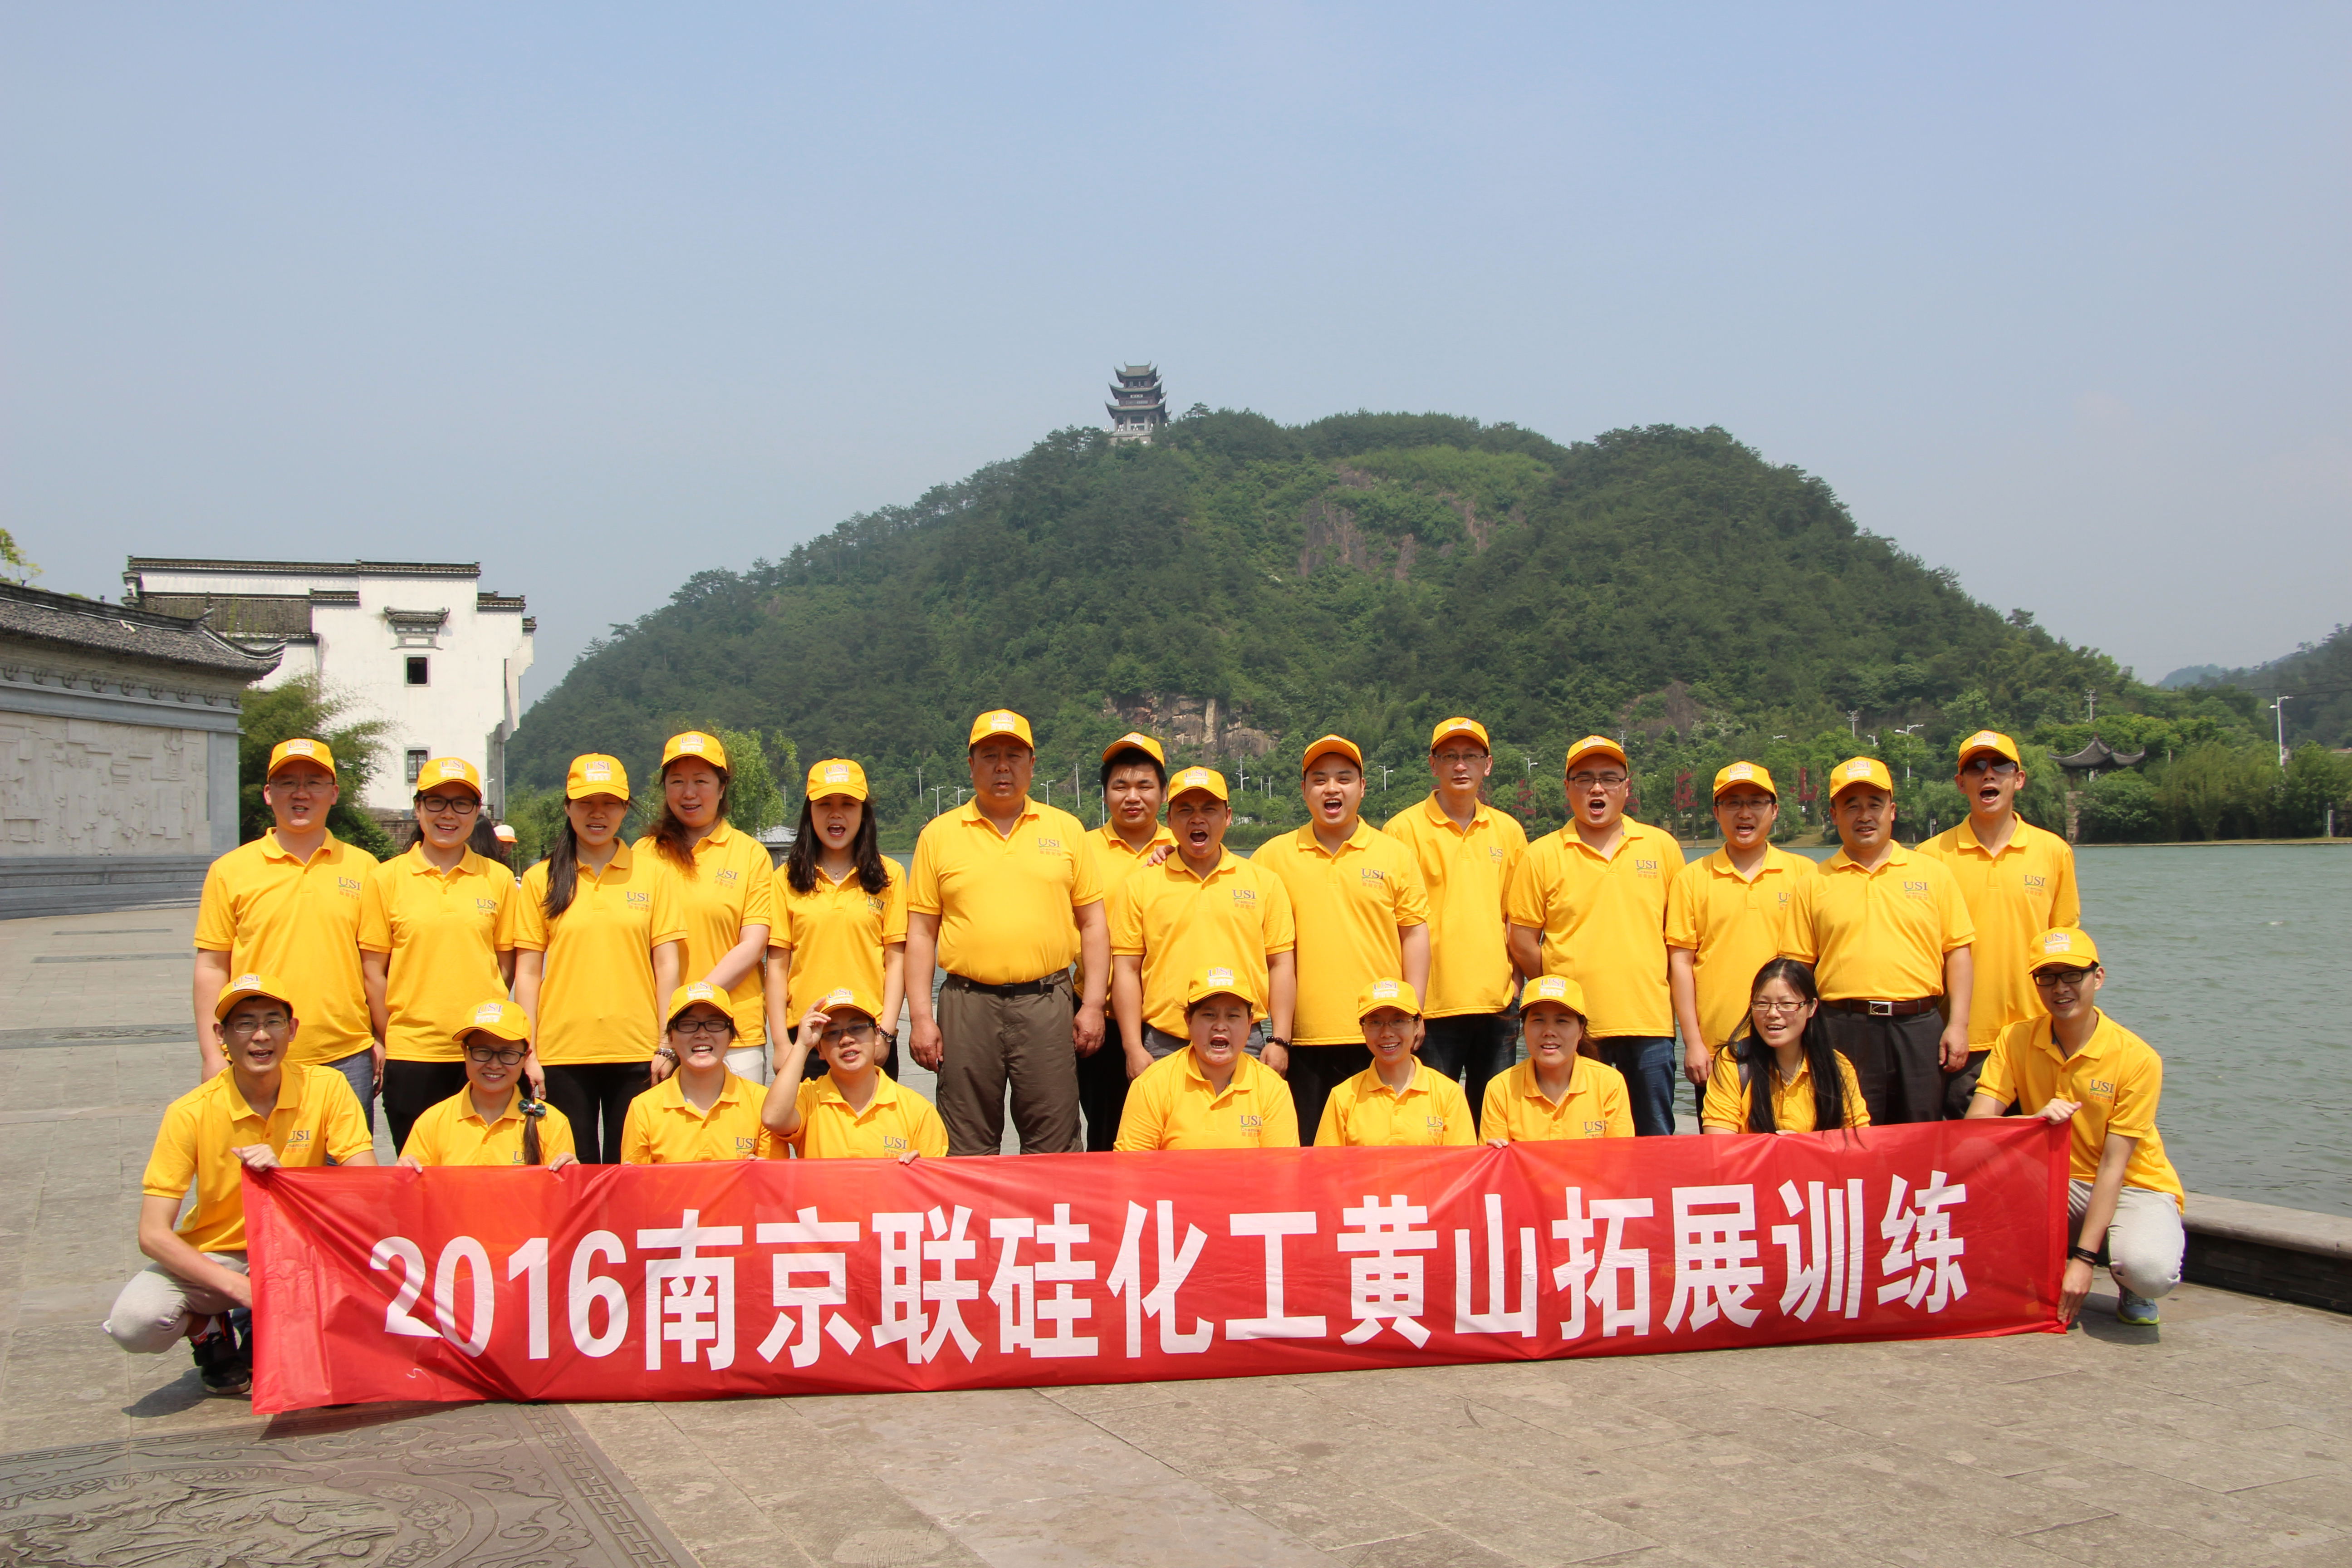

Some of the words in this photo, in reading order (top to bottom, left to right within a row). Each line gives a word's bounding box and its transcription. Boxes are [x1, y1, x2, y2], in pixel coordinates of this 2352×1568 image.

[992, 713, 1015, 722] USI
[681, 735, 704, 744] USI
[1973, 732, 1996, 741] USI
[288, 740, 313, 749] USI
[441, 760, 465, 770] USI
[586, 761, 610, 770] USI
[825, 764, 848, 774] USI
[1730, 764, 1751, 773] USI
[1847, 761, 1870, 770] USI
[1185, 769, 1207, 778] USI
[1038, 838, 1060, 848] USI
[1489, 847, 1503, 857] US
[1636, 860, 1658, 869] USI
[716, 868, 738, 880] USI
[1361, 868, 1385, 880] USI
[338, 877, 362, 891] USI
[2024, 875, 2046, 886] USI
[1903, 882, 1929, 891] USI
[626, 891, 650, 902] USI
[1232, 889, 1256, 899] USI
[475, 898, 498, 911] USI
[867, 896, 885, 911] USI
[2044, 933, 2068, 943] USI
[1208, 968, 1232, 977] USI
[234, 975, 259, 987] USI
[1374, 981, 1397, 990] USI
[1541, 978, 1564, 988] USI
[688, 982, 712, 991] USI
[828, 989, 853, 999] USI
[477, 1003, 502, 1014] USI
[2091, 1079, 2114, 1093] USI
[1240, 1115, 1262, 1126] USI
[1426, 1116, 1443, 1127] US
[1583, 1121, 1607, 1132] USI
[735, 1137, 757, 1149] USI
[883, 1136, 907, 1149] USI
[369, 1170, 1968, 1370] 2016南京联硅化工黄山拓展训练
